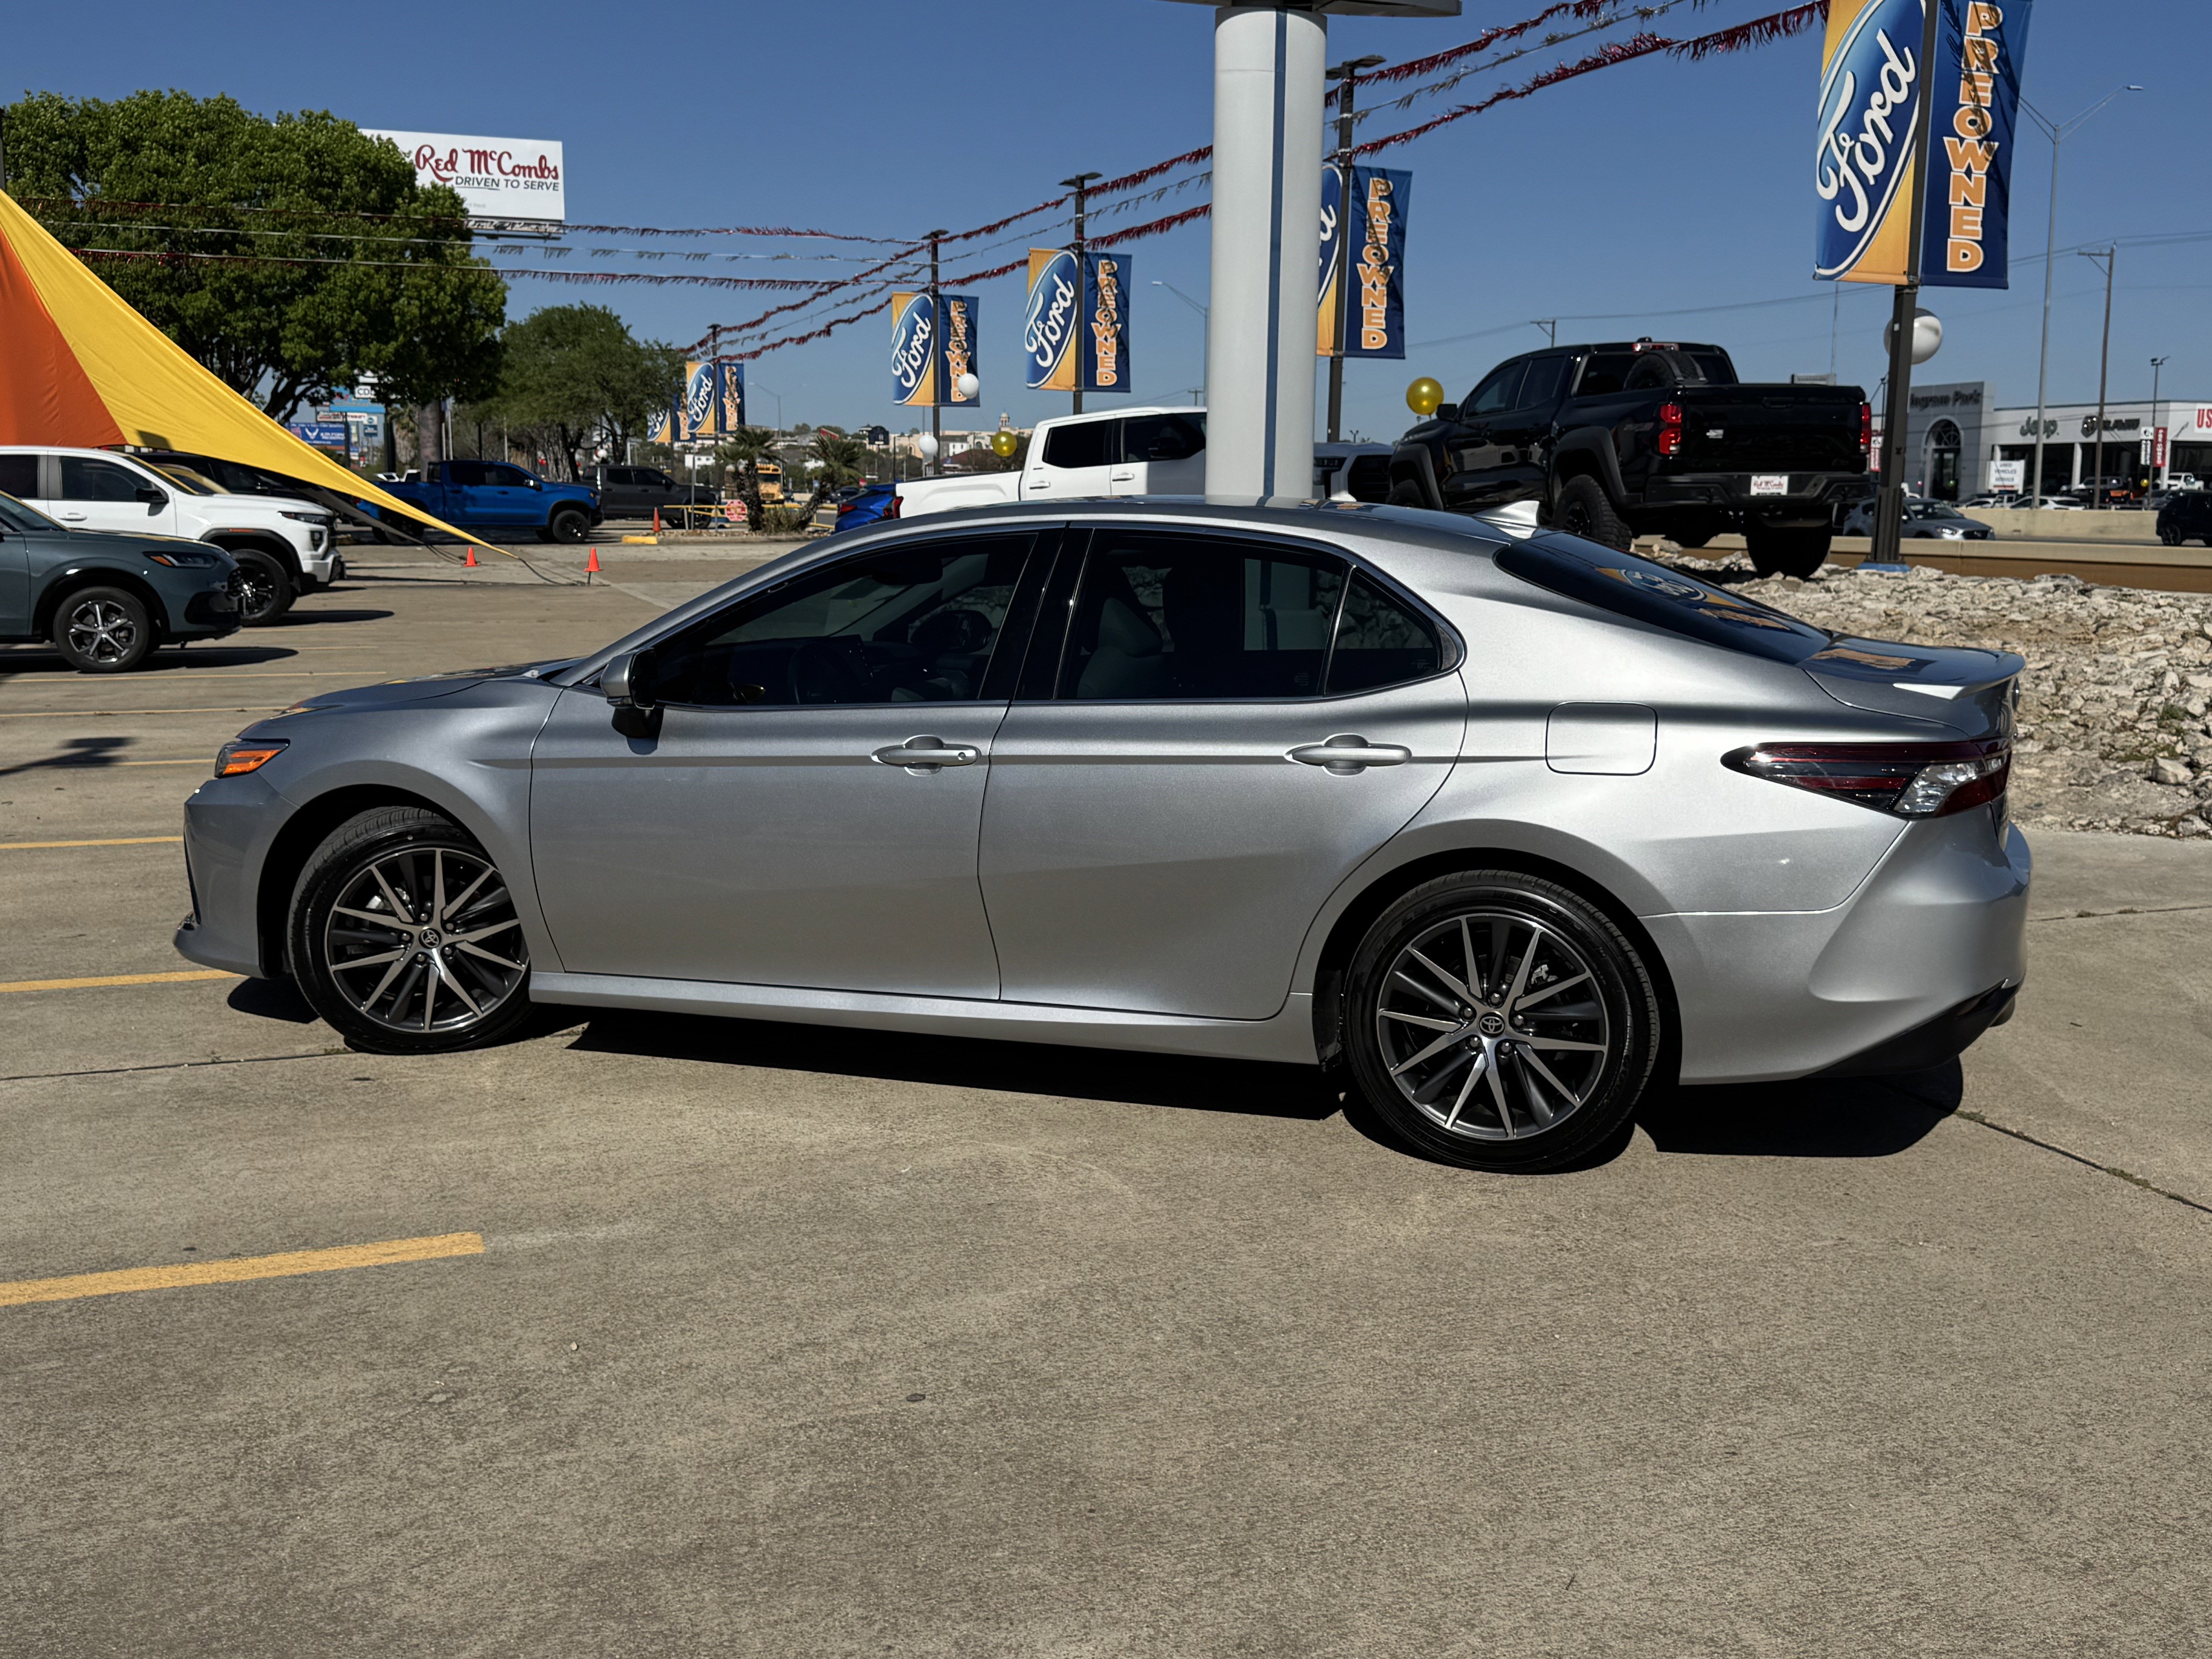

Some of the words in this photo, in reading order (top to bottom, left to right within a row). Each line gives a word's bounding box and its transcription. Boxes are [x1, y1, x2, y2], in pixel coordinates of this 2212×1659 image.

[415, 144, 459, 182] Red
[462, 148, 559, 180] McCombs
[1816, 28, 1916, 232] Ford
[1942, 0, 2003, 273] PREOWNED
[455, 176, 500, 188] DRIVEN
[504, 179, 520, 189] TO
[523, 180, 560, 191] SERVE
[1356, 177, 1394, 349] PREOWNED
[892, 311, 931, 388] Ford
[1025, 273, 1074, 368] Ford
[1091, 259, 1122, 386] PREOWNED
[687, 374, 713, 422] Ford
